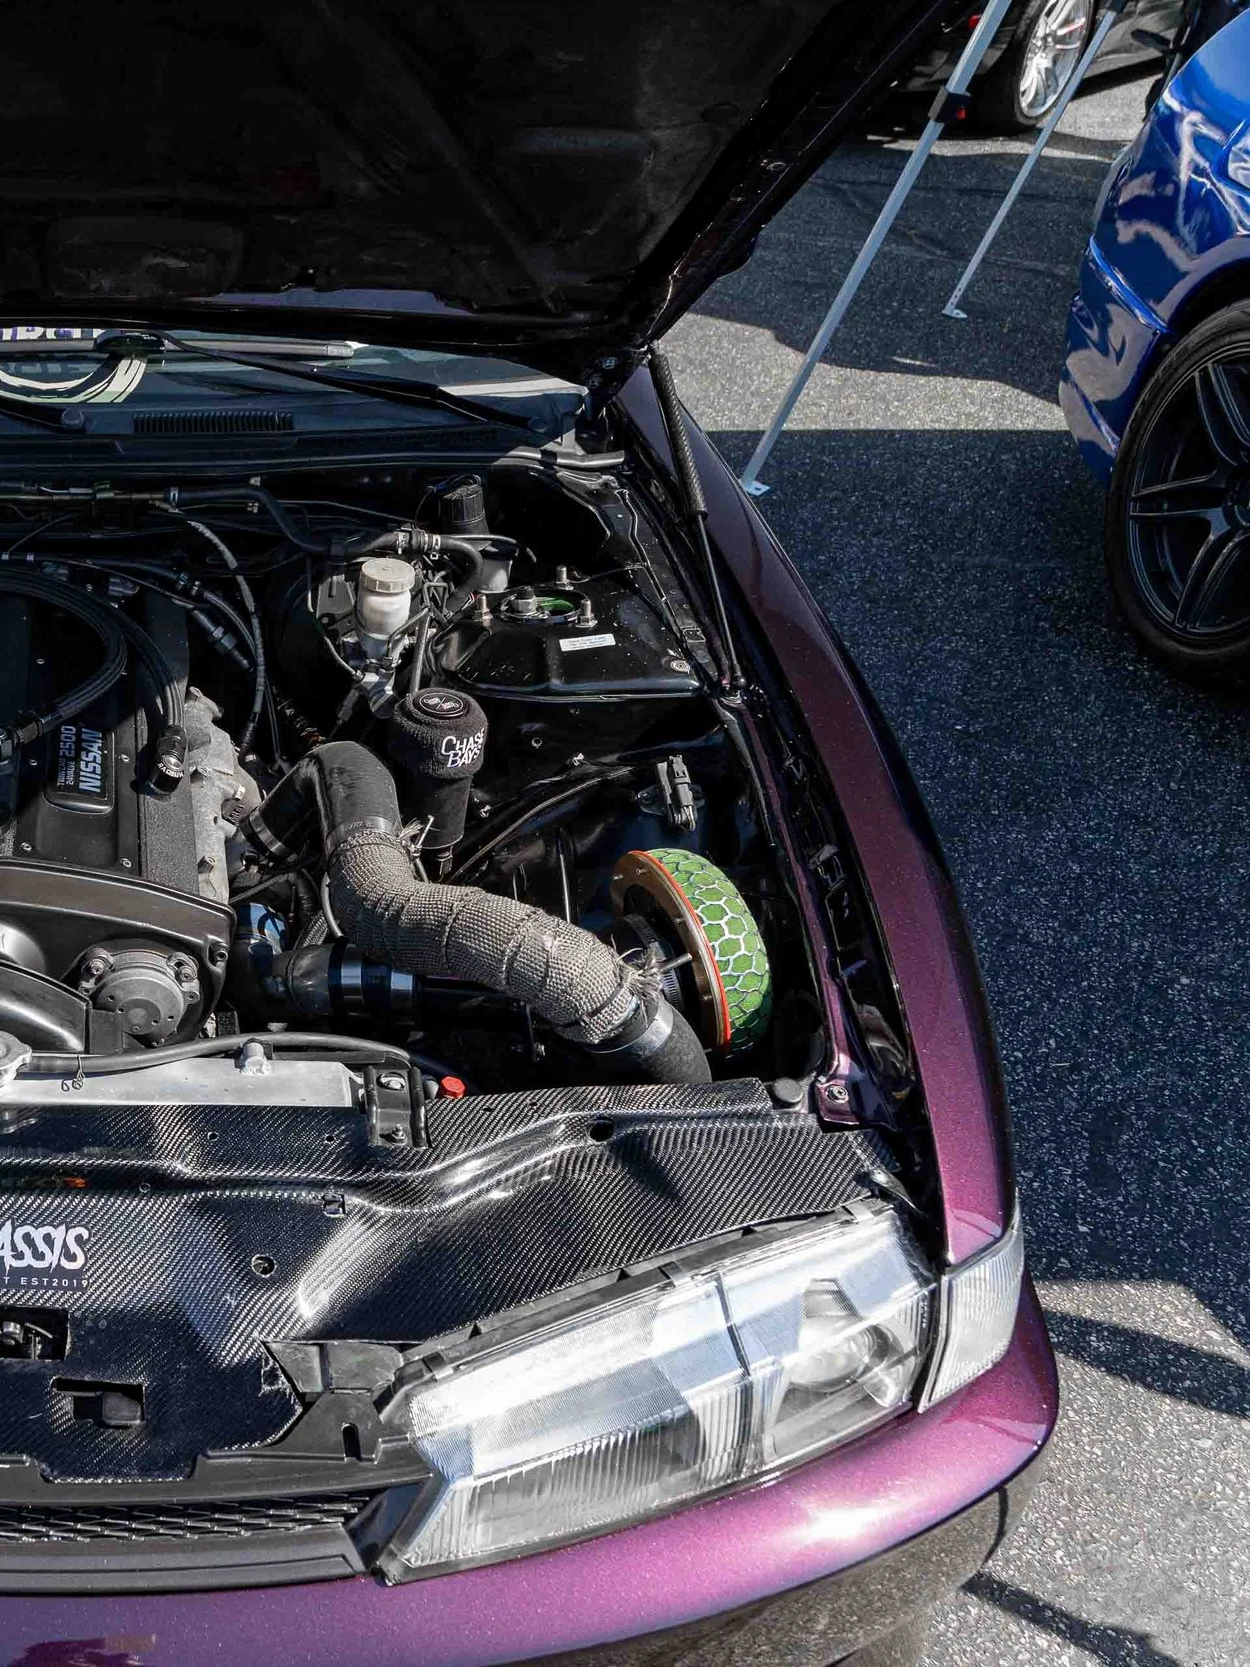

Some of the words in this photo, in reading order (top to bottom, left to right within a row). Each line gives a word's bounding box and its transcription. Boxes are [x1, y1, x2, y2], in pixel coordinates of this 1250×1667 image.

[60, 725, 76, 757] 2500
[441, 727, 485, 755] CHASE
[447, 745, 481, 767] BAYS
[79, 728, 102, 792] NISSAN
